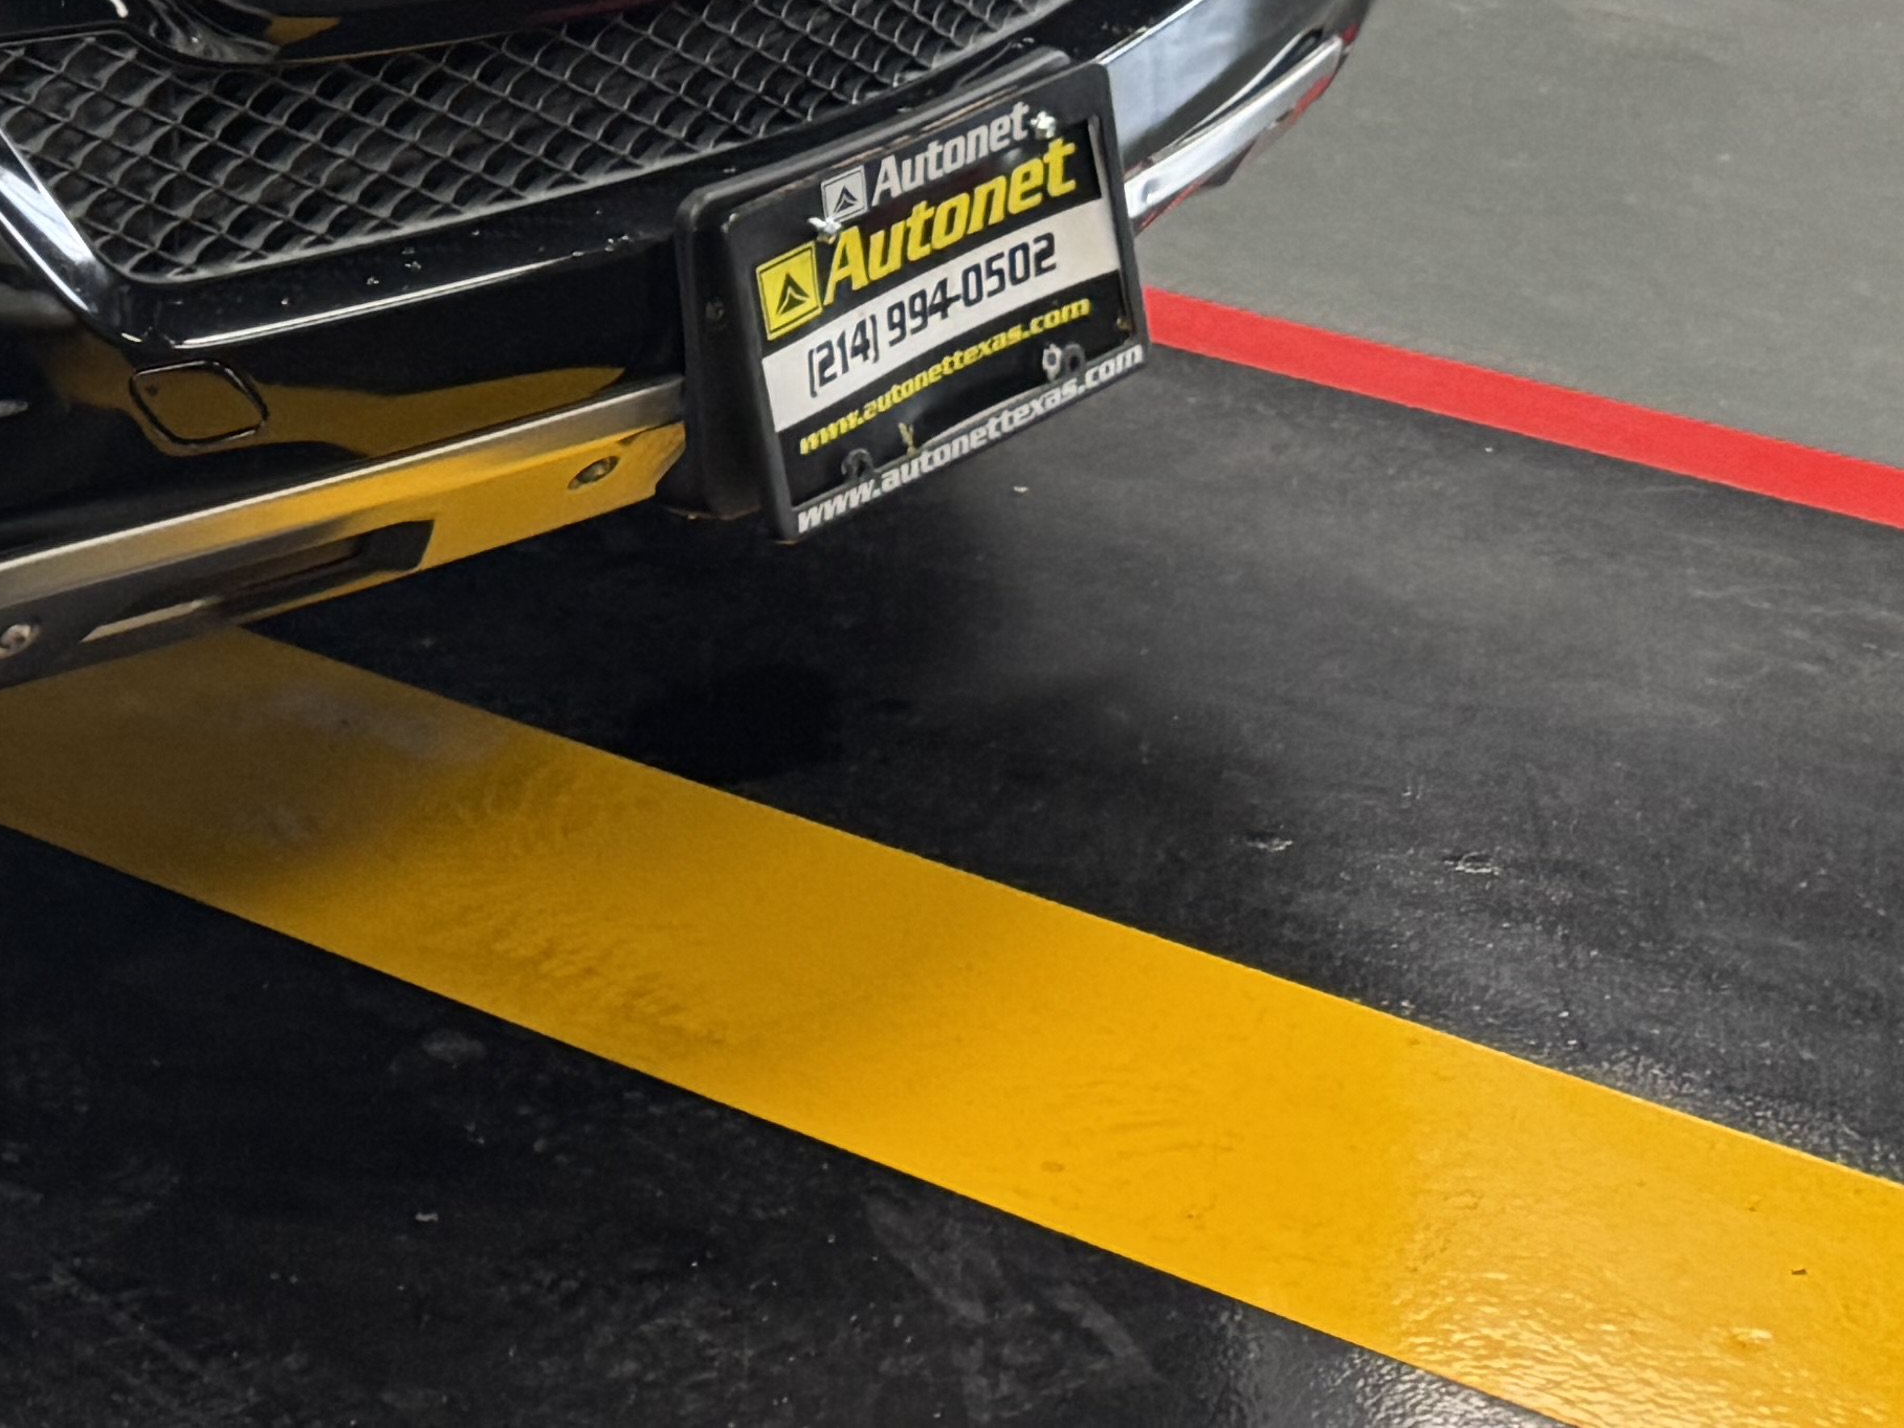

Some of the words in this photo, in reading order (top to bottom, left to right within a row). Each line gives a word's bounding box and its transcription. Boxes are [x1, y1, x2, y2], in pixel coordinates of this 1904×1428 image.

[823, 137, 1076, 306] Autonet
[871, 101, 1029, 207] Autonet
[800, 298, 1090, 455] www.autonettexas.com
[808, 314, 878, 398] (214)
[887, 232, 1056, 347] 994-0502
[798, 344, 1143, 533] www.autonettexas.com
